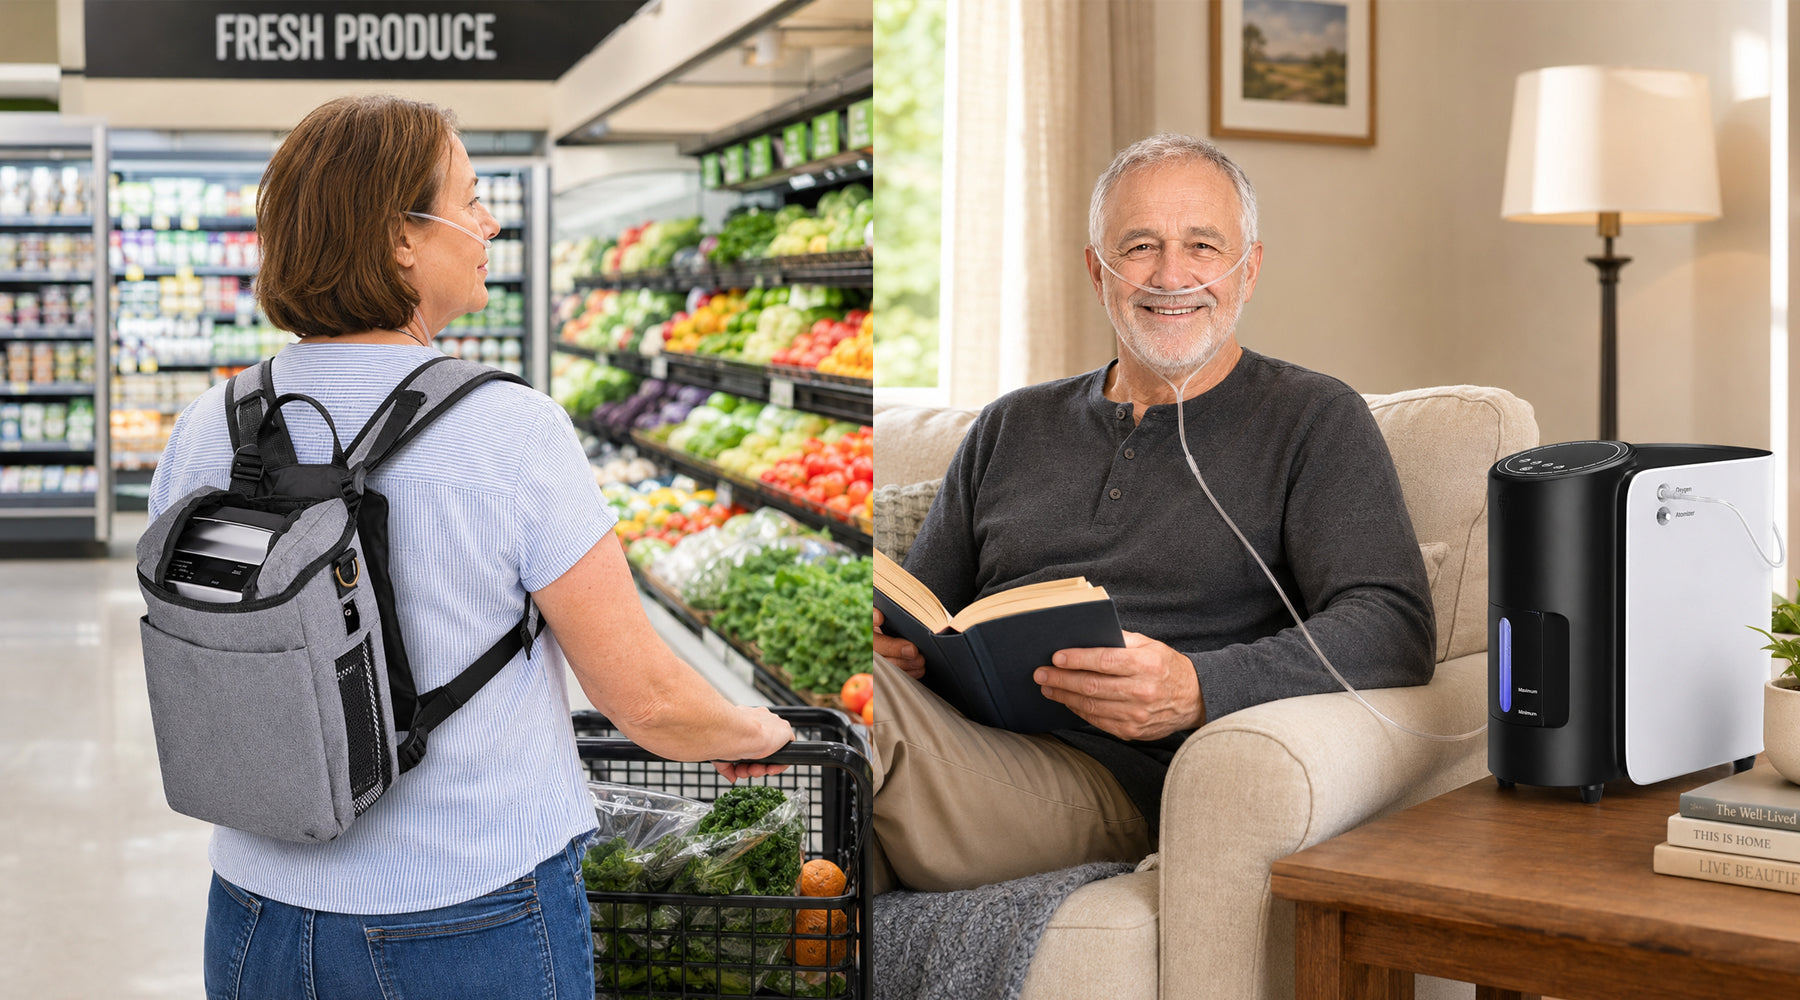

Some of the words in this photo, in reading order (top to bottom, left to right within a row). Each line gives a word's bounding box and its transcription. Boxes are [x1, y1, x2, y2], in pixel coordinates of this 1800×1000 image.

[215, 13, 325, 61] FRESH
[334, 13, 497, 61] PRODUCE
[1675, 486, 1693, 494] Oxygen
[1675, 510, 1695, 518] Atomizer
[1716, 803, 1737, 817] The
[1740, 806, 1797, 825] Well-Lived
[1693, 829, 1720, 841] THIS
[1723, 833, 1733, 844] IS
[1736, 835, 1771, 849] HOME
[1700, 859, 1731, 876] LIVE
